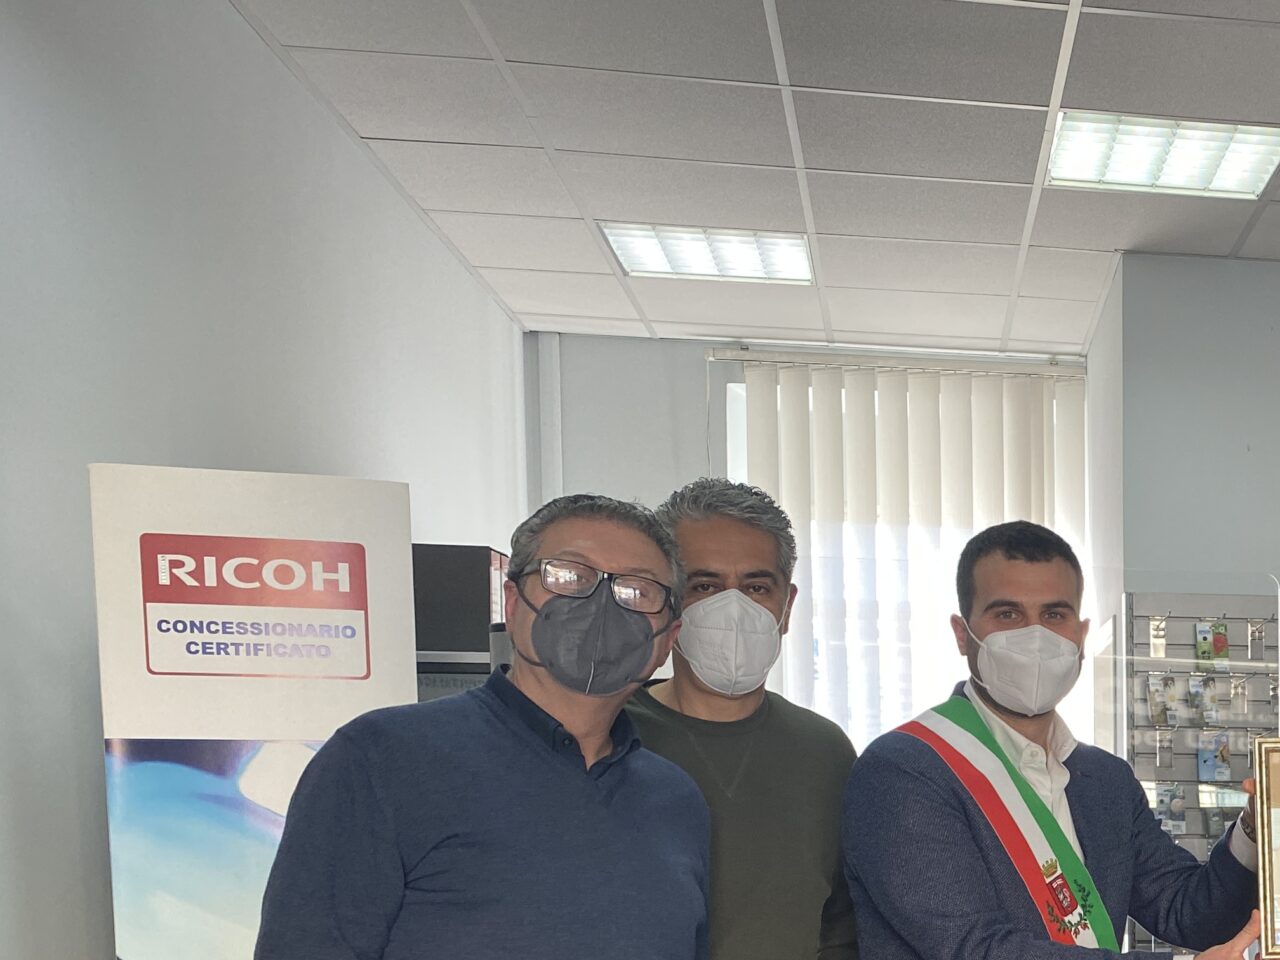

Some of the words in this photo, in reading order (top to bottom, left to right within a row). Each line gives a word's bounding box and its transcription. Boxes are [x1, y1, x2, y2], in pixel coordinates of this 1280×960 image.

[156, 553, 350, 593] RICOH
[156, 618, 357, 640] CONCESSIONARIO
[185, 641, 332, 659] CERTIFICATO
